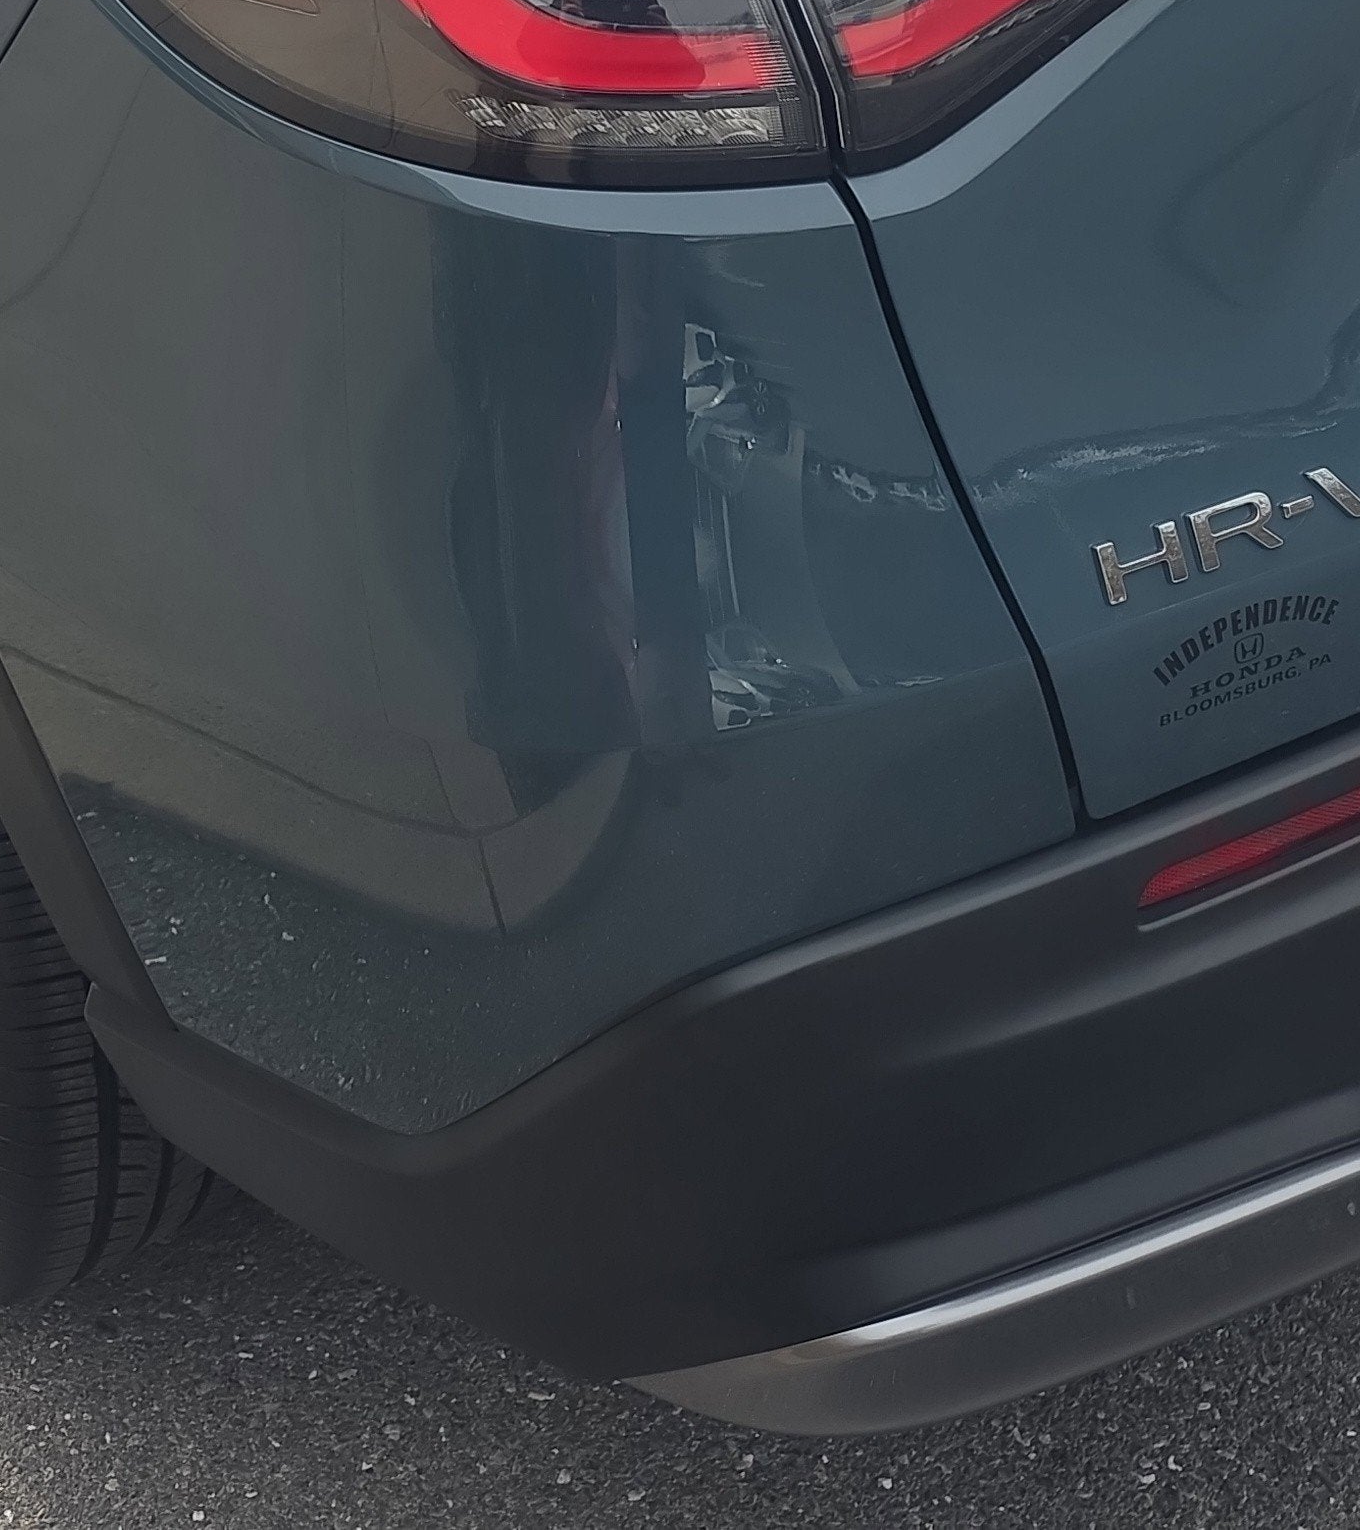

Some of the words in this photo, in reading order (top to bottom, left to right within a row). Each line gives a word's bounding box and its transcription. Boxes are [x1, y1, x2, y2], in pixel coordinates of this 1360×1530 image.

[1152, 594, 1340, 687] INDEPENDENCE
[1189, 646, 1307, 699] HONDA
[1159, 666, 1304, 727] BLOOMSBURG,
[1308, 653, 1332, 671] PA
